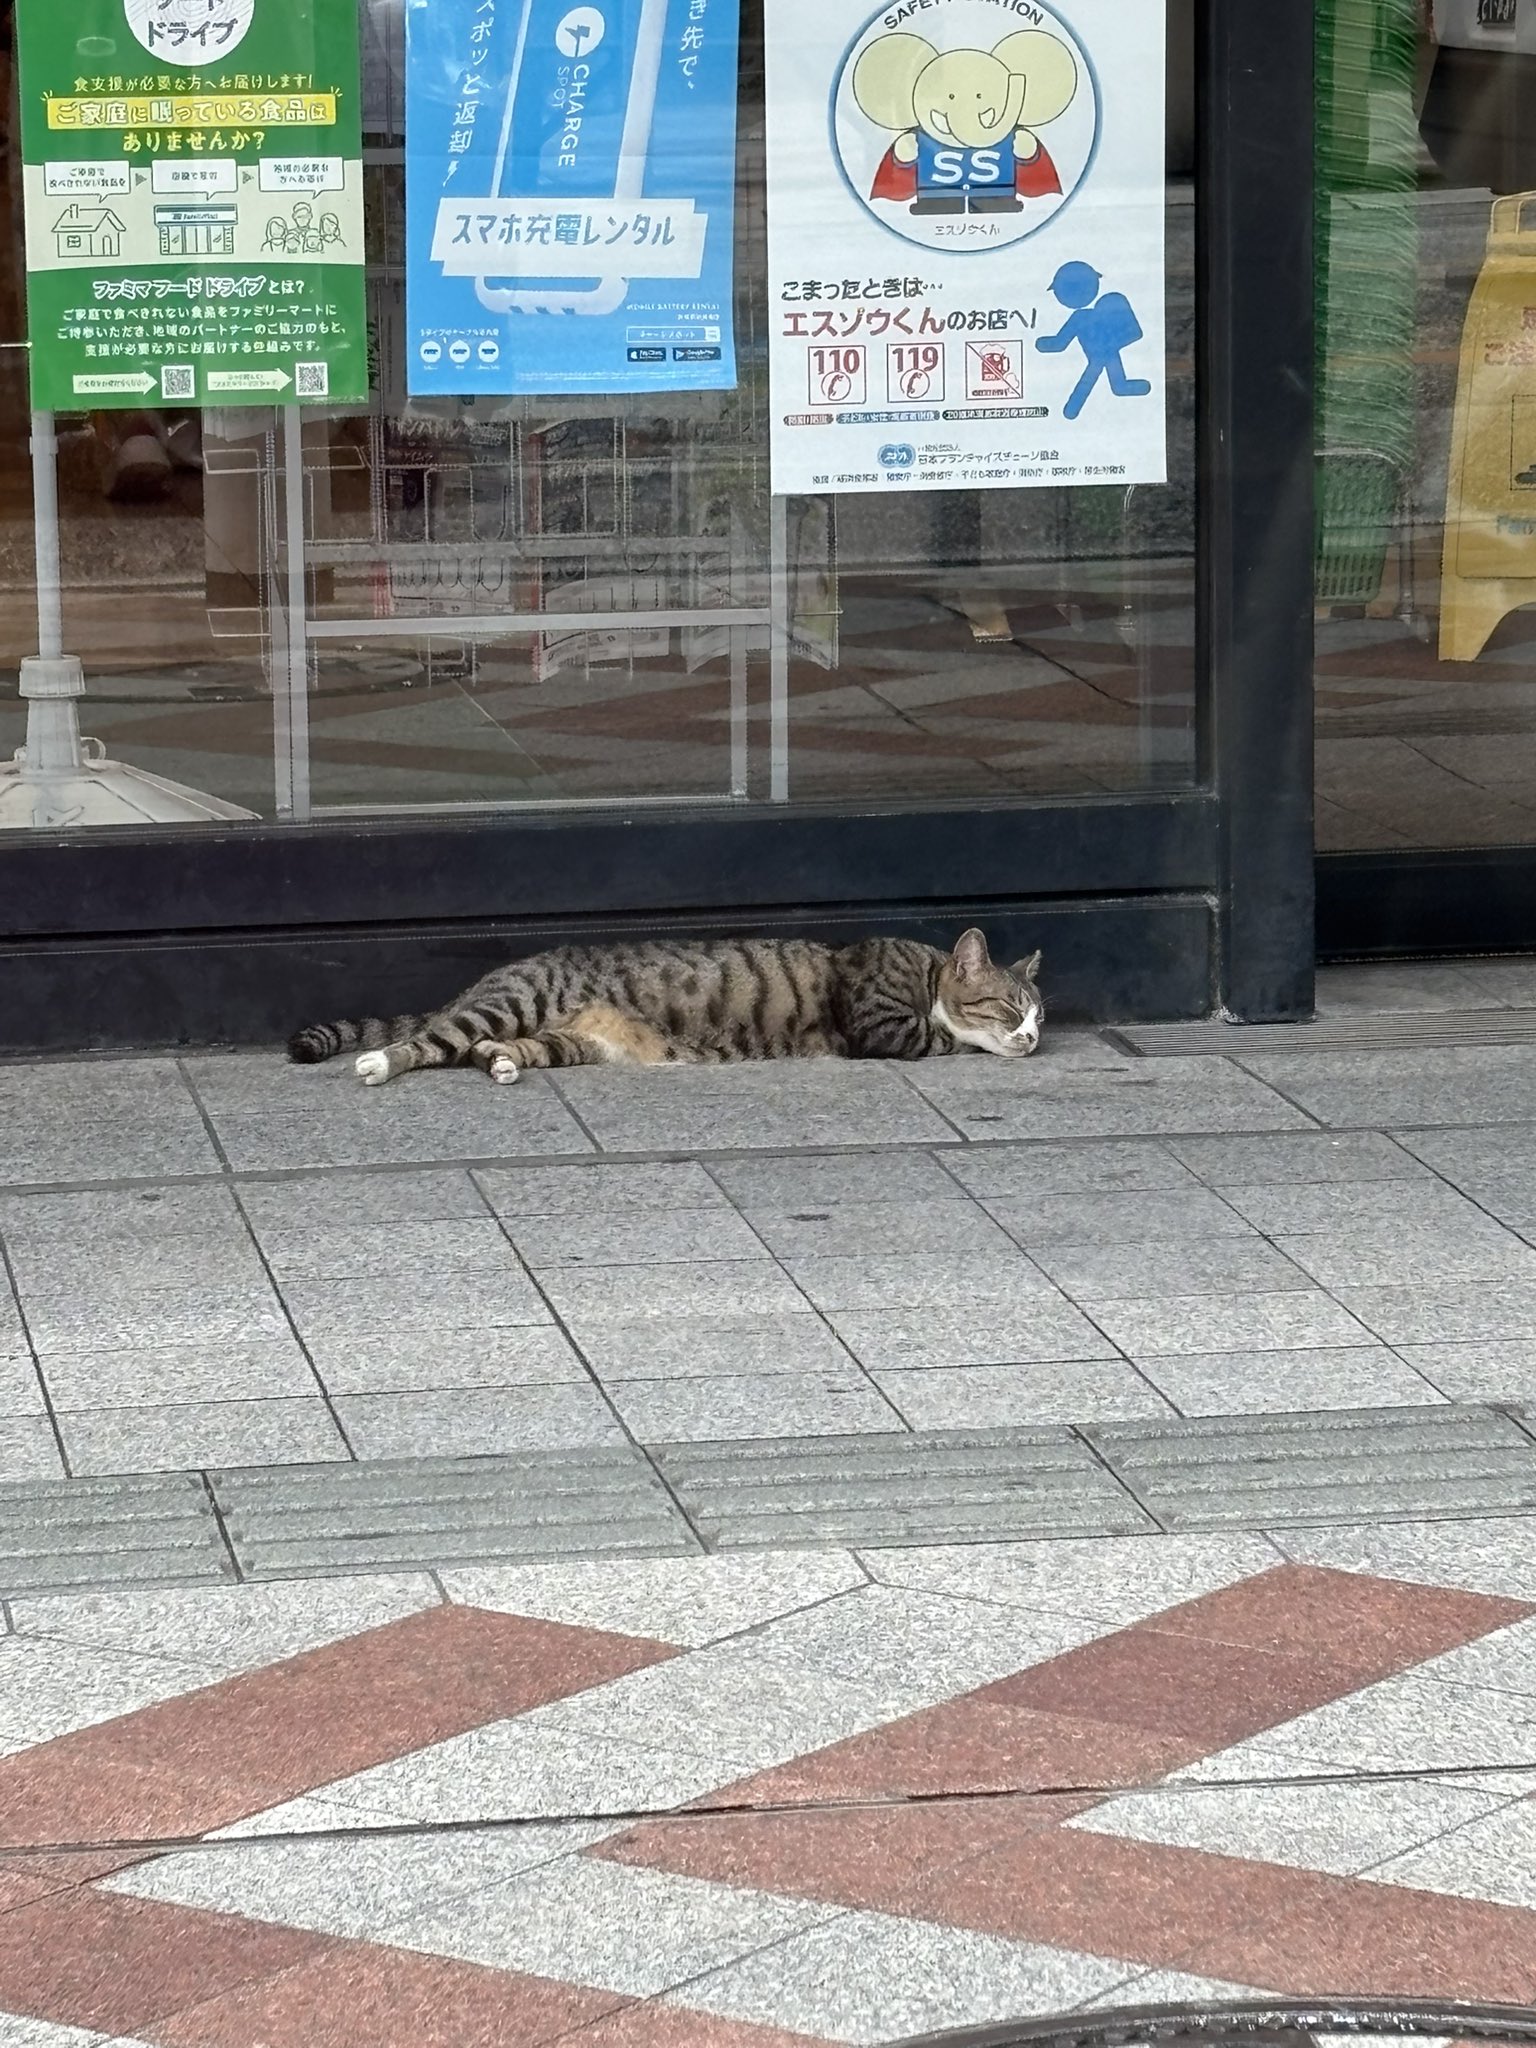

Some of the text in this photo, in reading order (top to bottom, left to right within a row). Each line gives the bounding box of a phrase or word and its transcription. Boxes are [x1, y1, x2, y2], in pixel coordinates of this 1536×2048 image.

[148, 18, 239, 47] ドライブ
[552, 66, 570, 109] SPOT
[56, 100, 327, 125] ご家庭に眠っている食品は
[557, 64, 590, 168] CHARGE
[122, 131, 266, 152] ありませんか?
[931, 150, 1001, 184] SS
[451, 213, 676, 246] スマホ充電レンタル
[812, 349, 860, 375] 110
[892, 345, 939, 371] 119
